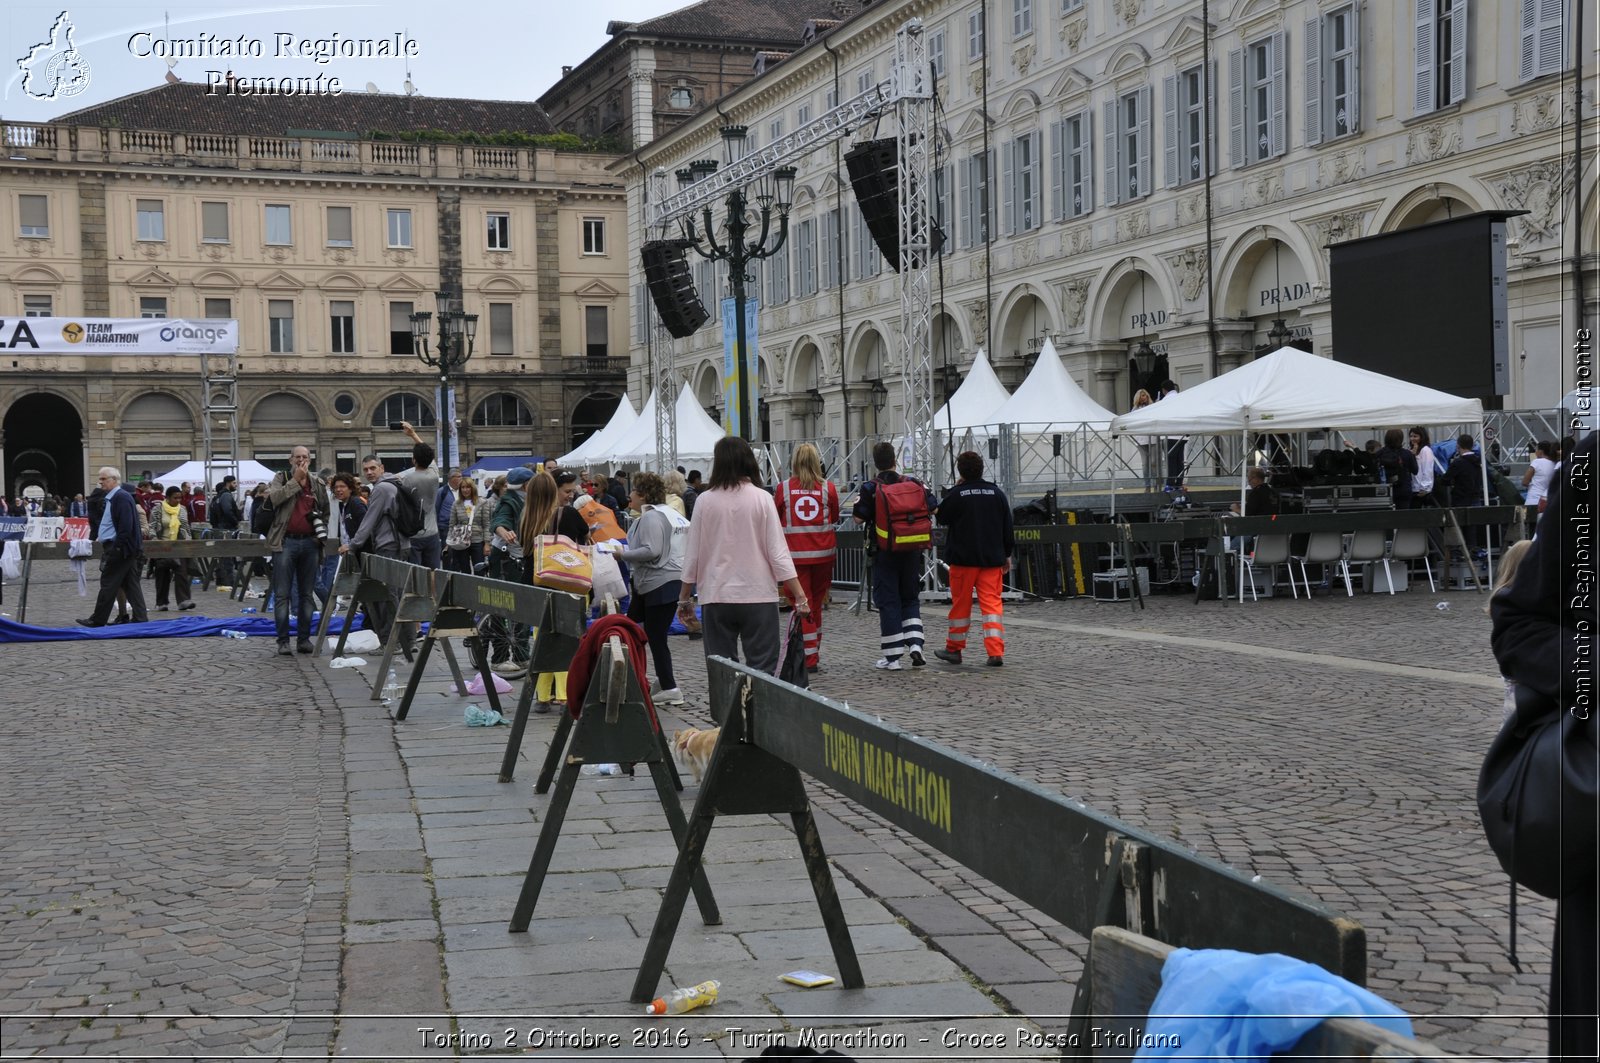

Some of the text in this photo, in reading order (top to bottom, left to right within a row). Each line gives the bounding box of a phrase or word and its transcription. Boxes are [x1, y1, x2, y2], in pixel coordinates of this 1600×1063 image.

[1260, 282, 1311, 307] PRADA
[86, 323, 112, 333] TEAM
[1131, 310, 1169, 329] PRAD
[0, 320, 40, 348] A
[86, 333, 139, 343] MARATHON
[1013, 529, 1041, 540] THON
[822, 722, 951, 834] TURIN MARATHON
